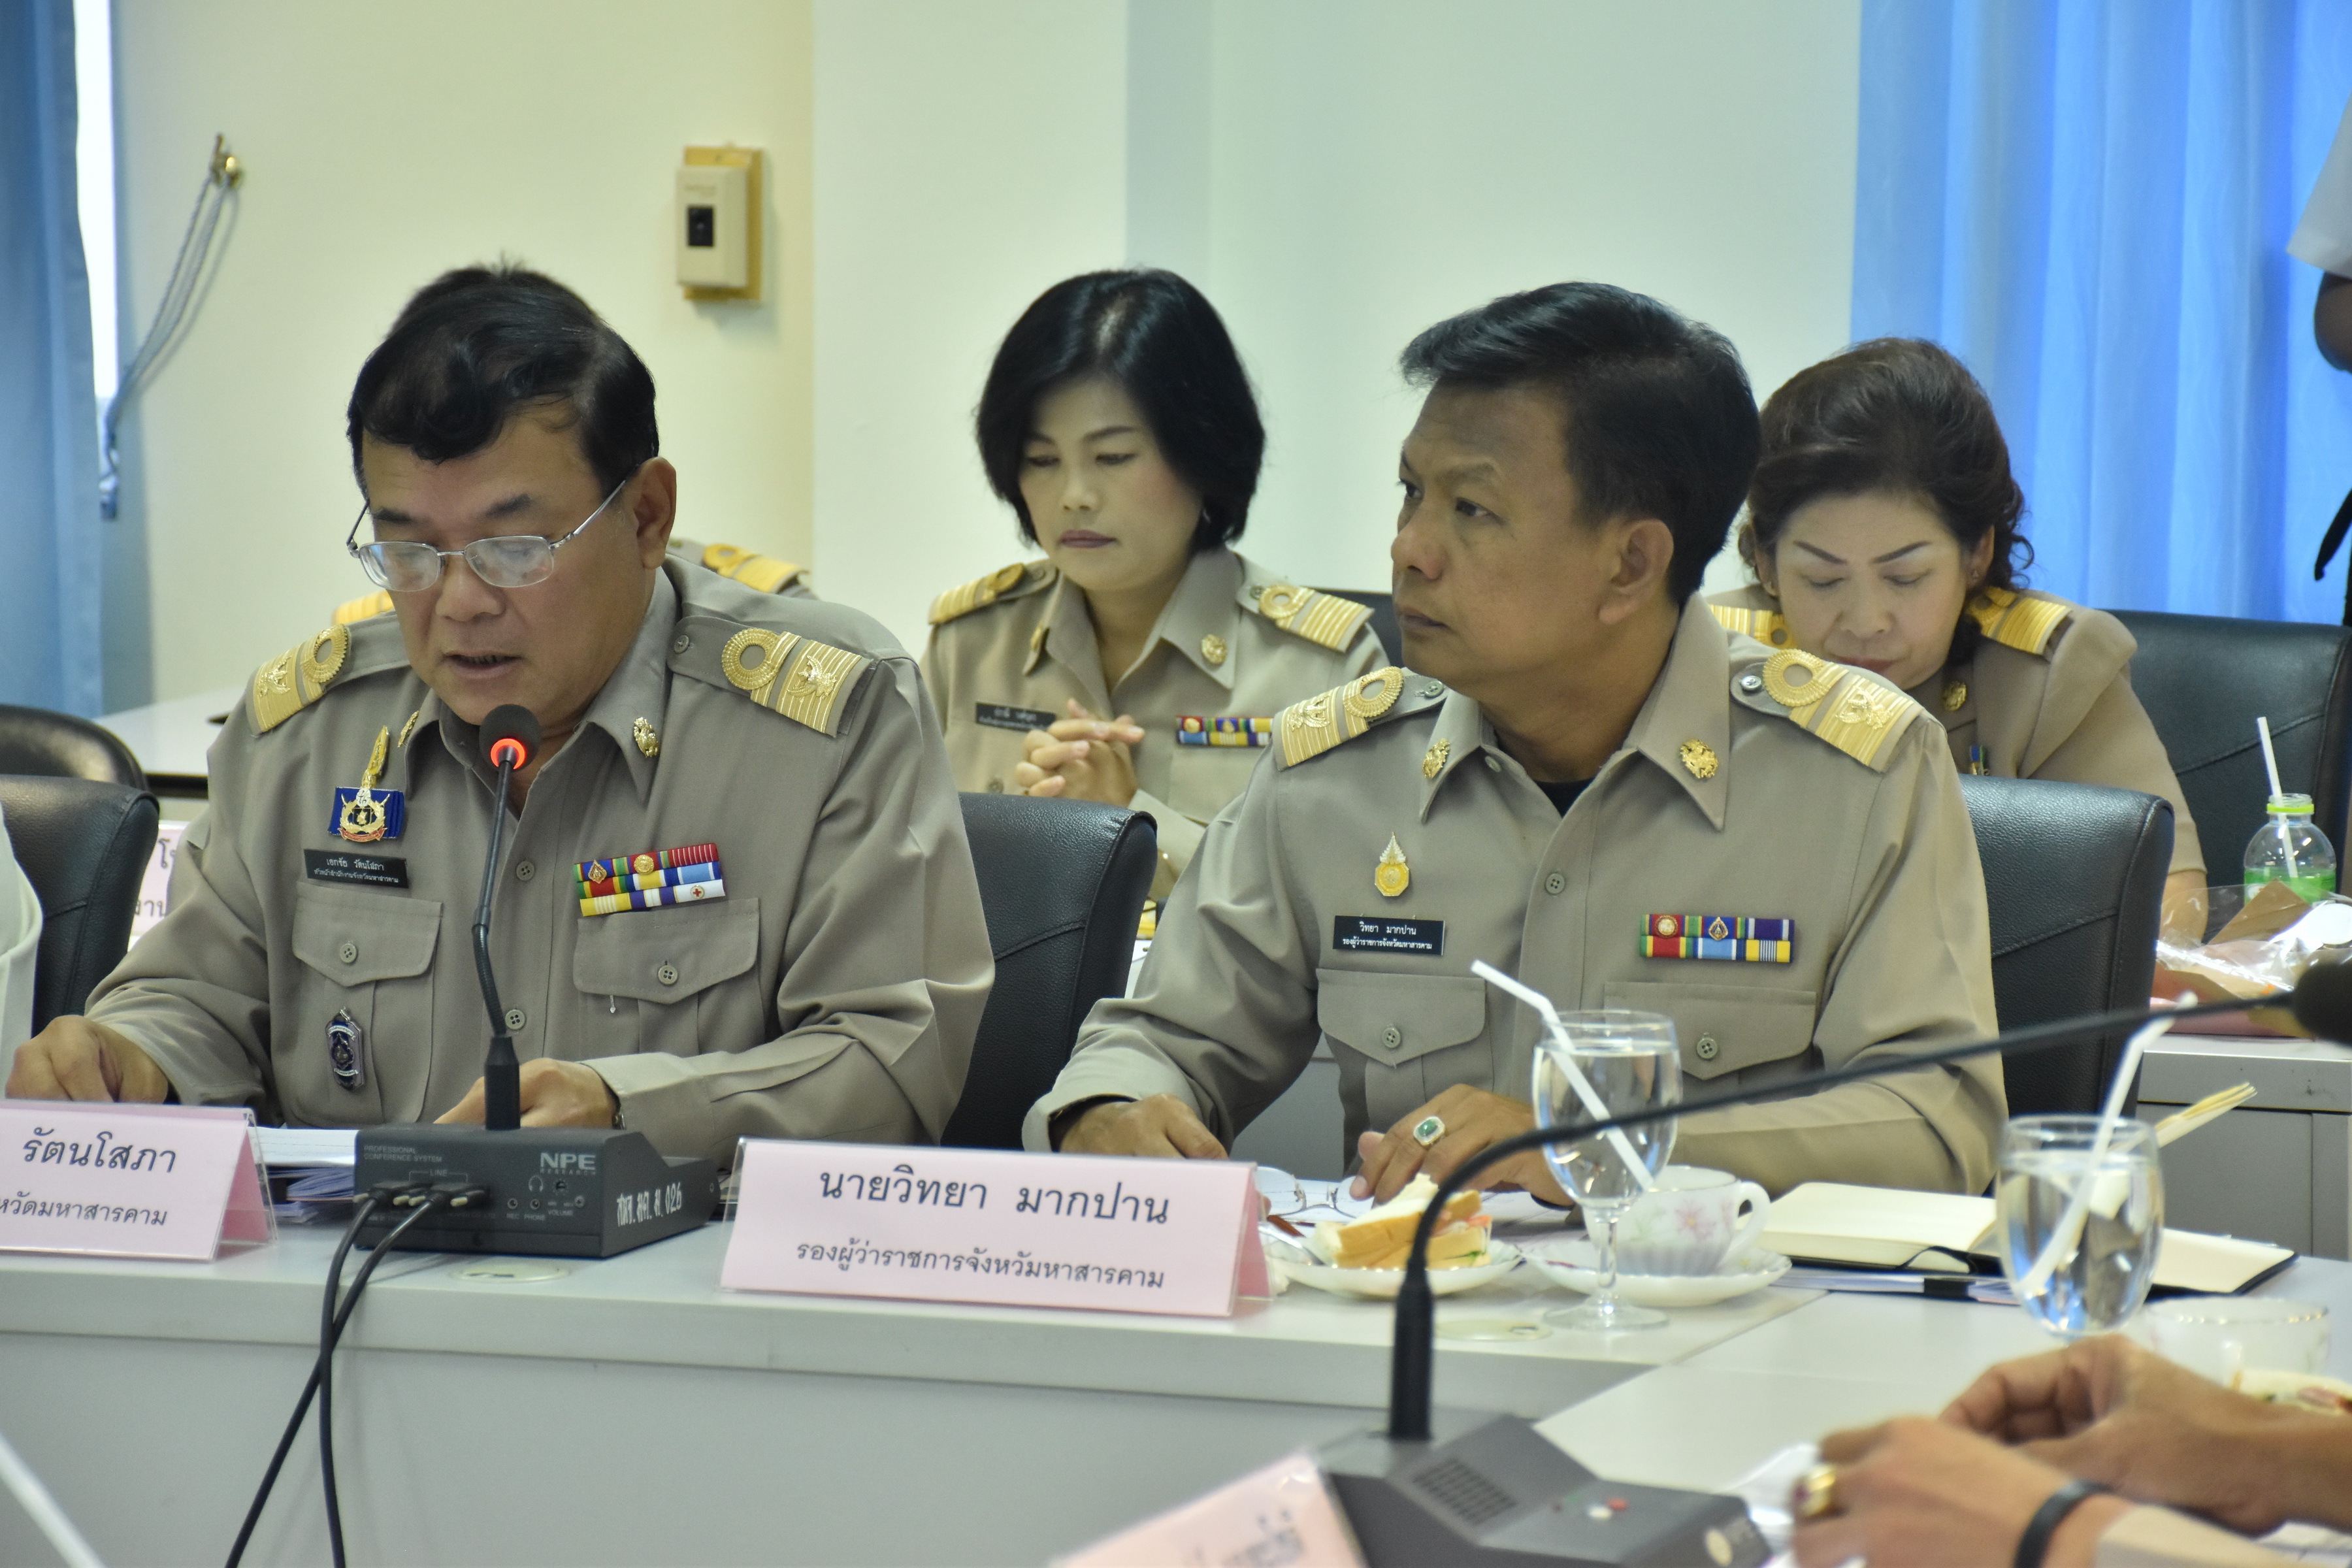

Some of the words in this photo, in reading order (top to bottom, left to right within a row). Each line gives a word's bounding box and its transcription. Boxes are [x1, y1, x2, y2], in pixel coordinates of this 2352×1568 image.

[1359, 921, 1379, 933] วิทยา
[1386, 924, 1417, 936] มากปาน
[23, 1127, 176, 1173] รัตนโสภา
[364, 1145, 416, 1154] PROFESSIONAL
[364, 1153, 412, 1162] CONFERENCE
[540, 1152, 596, 1171] NPE
[820, 1164, 987, 1209] นายวิทยา
[1015, 1182, 1169, 1224] มากปาน
